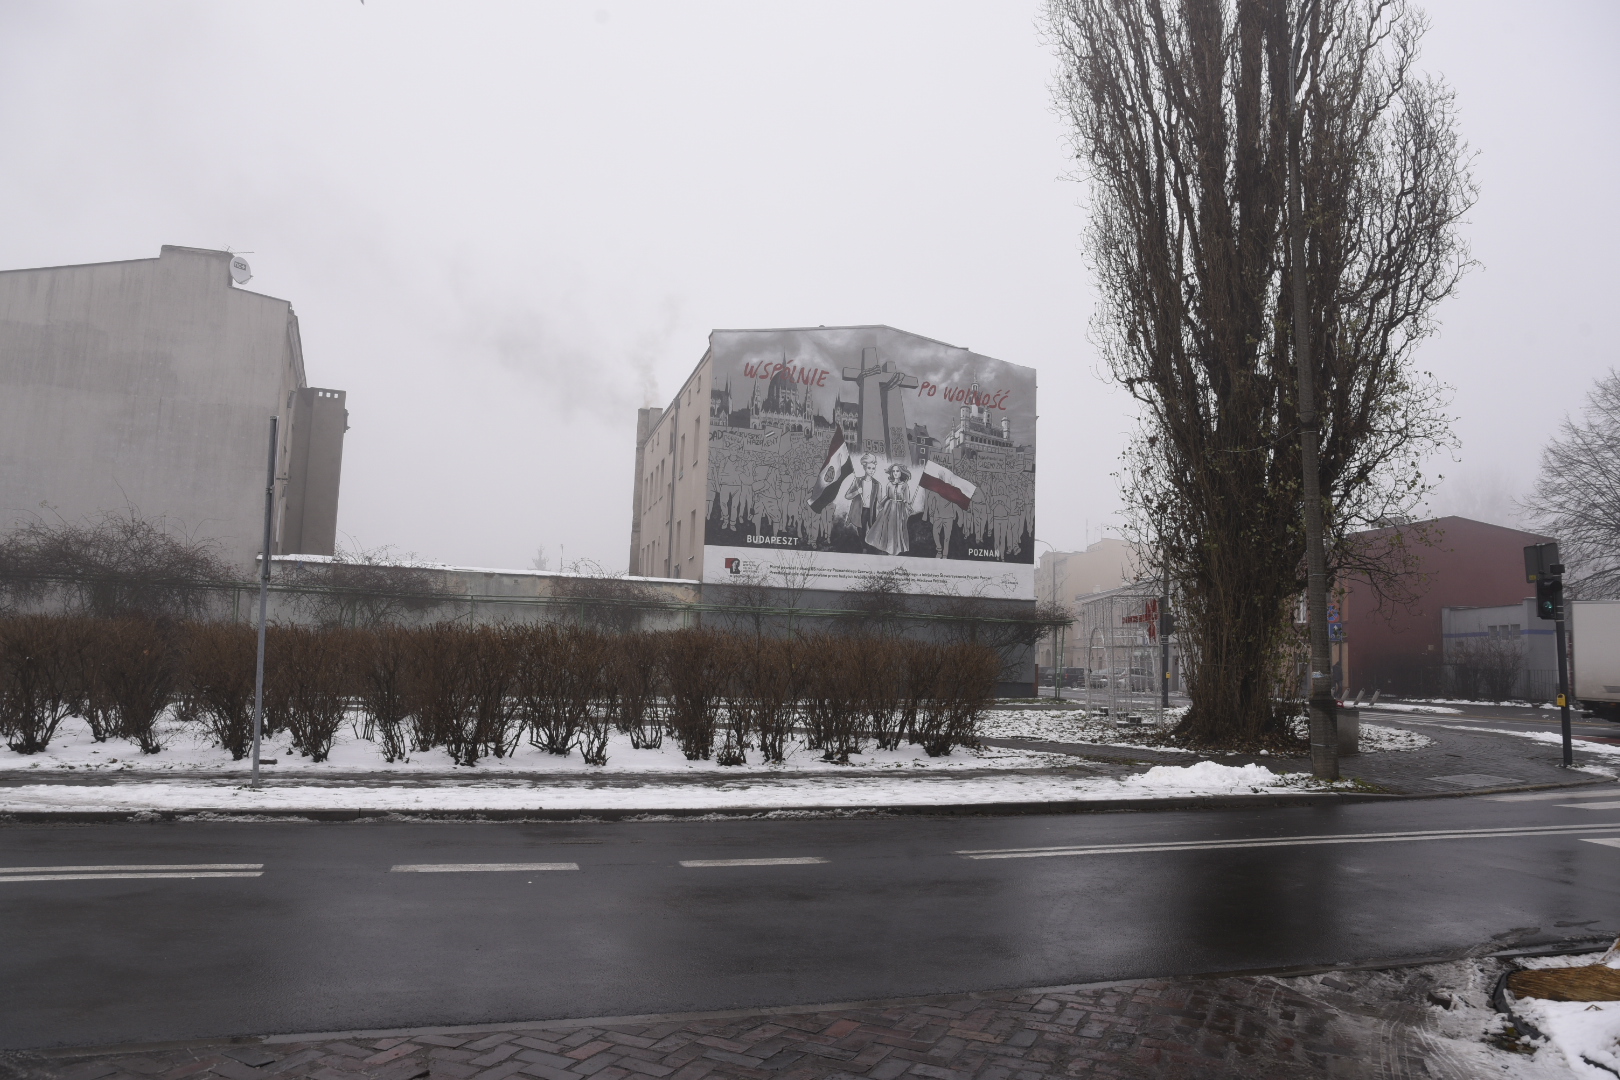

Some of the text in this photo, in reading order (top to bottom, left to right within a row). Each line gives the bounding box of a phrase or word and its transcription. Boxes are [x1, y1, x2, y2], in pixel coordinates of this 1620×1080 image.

[743, 359, 830, 387] WSPÓLNIE
[917, 381, 1011, 411] PO WOLNOŚĆ
[862, 439, 886, 454] 1956
[746, 534, 799, 546] BUDAPESZT
